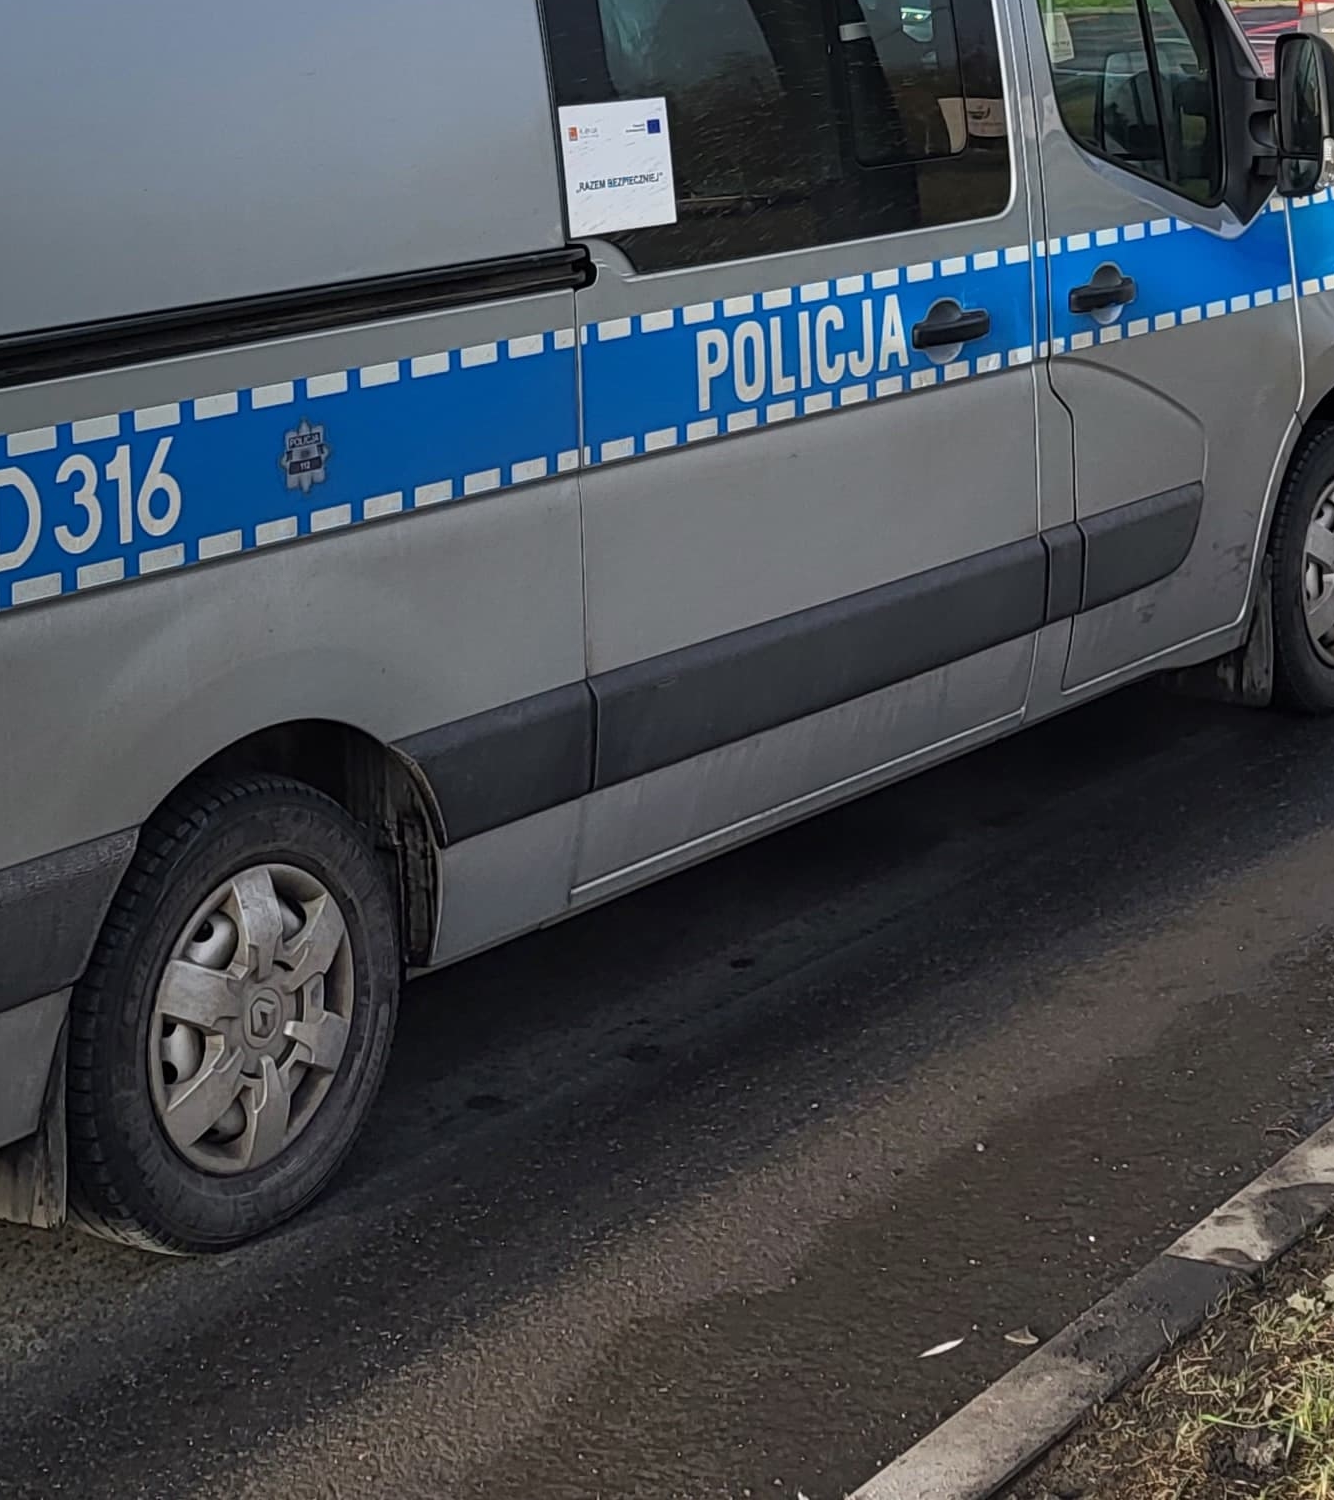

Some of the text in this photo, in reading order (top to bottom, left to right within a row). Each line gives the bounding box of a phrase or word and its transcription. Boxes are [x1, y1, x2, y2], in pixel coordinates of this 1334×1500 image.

[696, 293, 910, 412] POLICJA
[53, 436, 182, 555] 316
[289, 433, 320, 447] POLICJA
